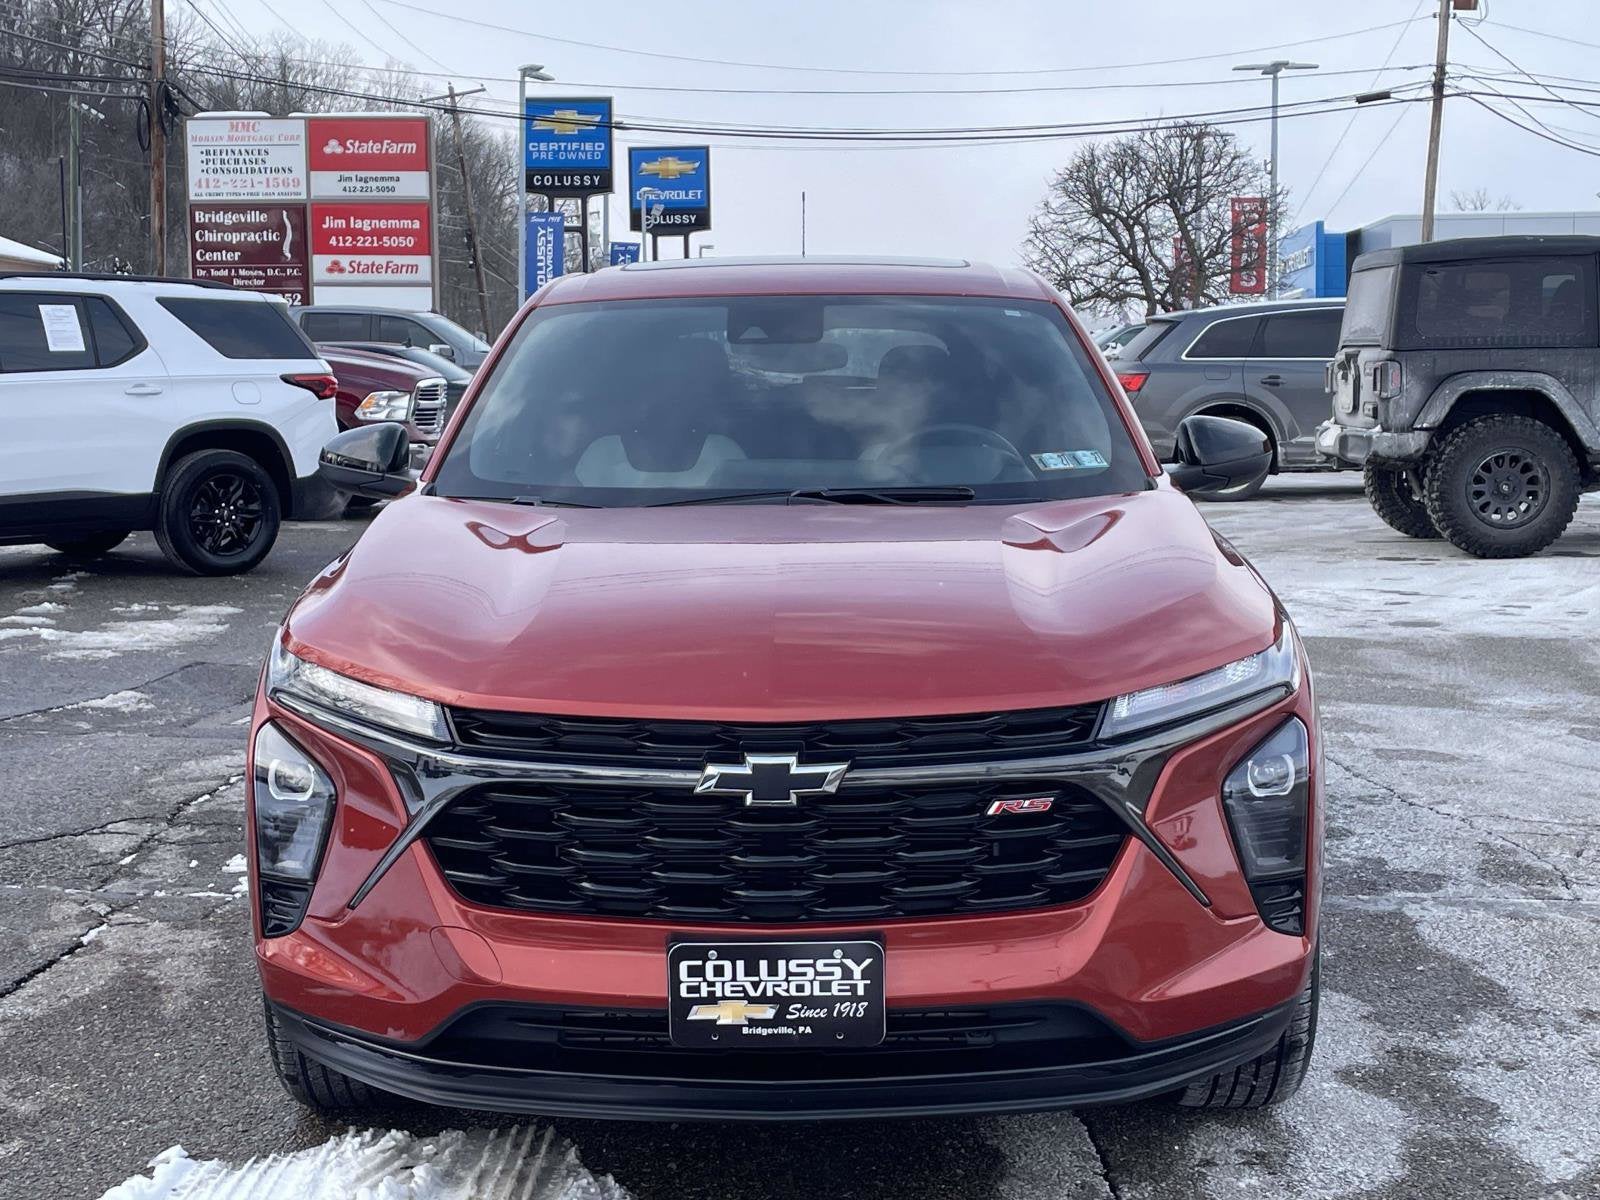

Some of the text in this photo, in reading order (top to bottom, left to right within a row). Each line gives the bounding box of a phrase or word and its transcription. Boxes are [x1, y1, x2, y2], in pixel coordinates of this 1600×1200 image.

[228, 121, 260, 133] MMC
[205, 148, 270, 156] REFINANCES
[528, 142, 605, 151] CERTIFIED
[205, 157, 267, 165] PURCHASES
[532, 151, 602, 160] PRE-OWNED
[206, 167, 293, 175] CONSOLIDATIONS
[195, 177, 301, 189] 412-221-1569
[337, 174, 353, 183] Jim
[533, 175, 600, 186] COLUSSY
[636, 190, 703, 201] CHEVROLET
[194, 210, 268, 226] Bridgeville
[322, 216, 346, 229] Jim
[644, 214, 697, 224] COLUSSY
[194, 229, 281, 244] Chiropractic
[329, 236, 415, 247] 412-221-5050
[195, 249, 241, 262] Center
[537, 226, 546, 290] OLUSSY
[196, 269, 209, 277] Dr.
[233, 278, 265, 286] Director
[987, 797, 1055, 815] RS
[679, 957, 874, 983] COLUSSY
[679, 980, 871, 998] CHEVROLET
[785, 1001, 869, 1020] Since 1918
[742, 1026, 812, 1036] Bridgeville, PA
